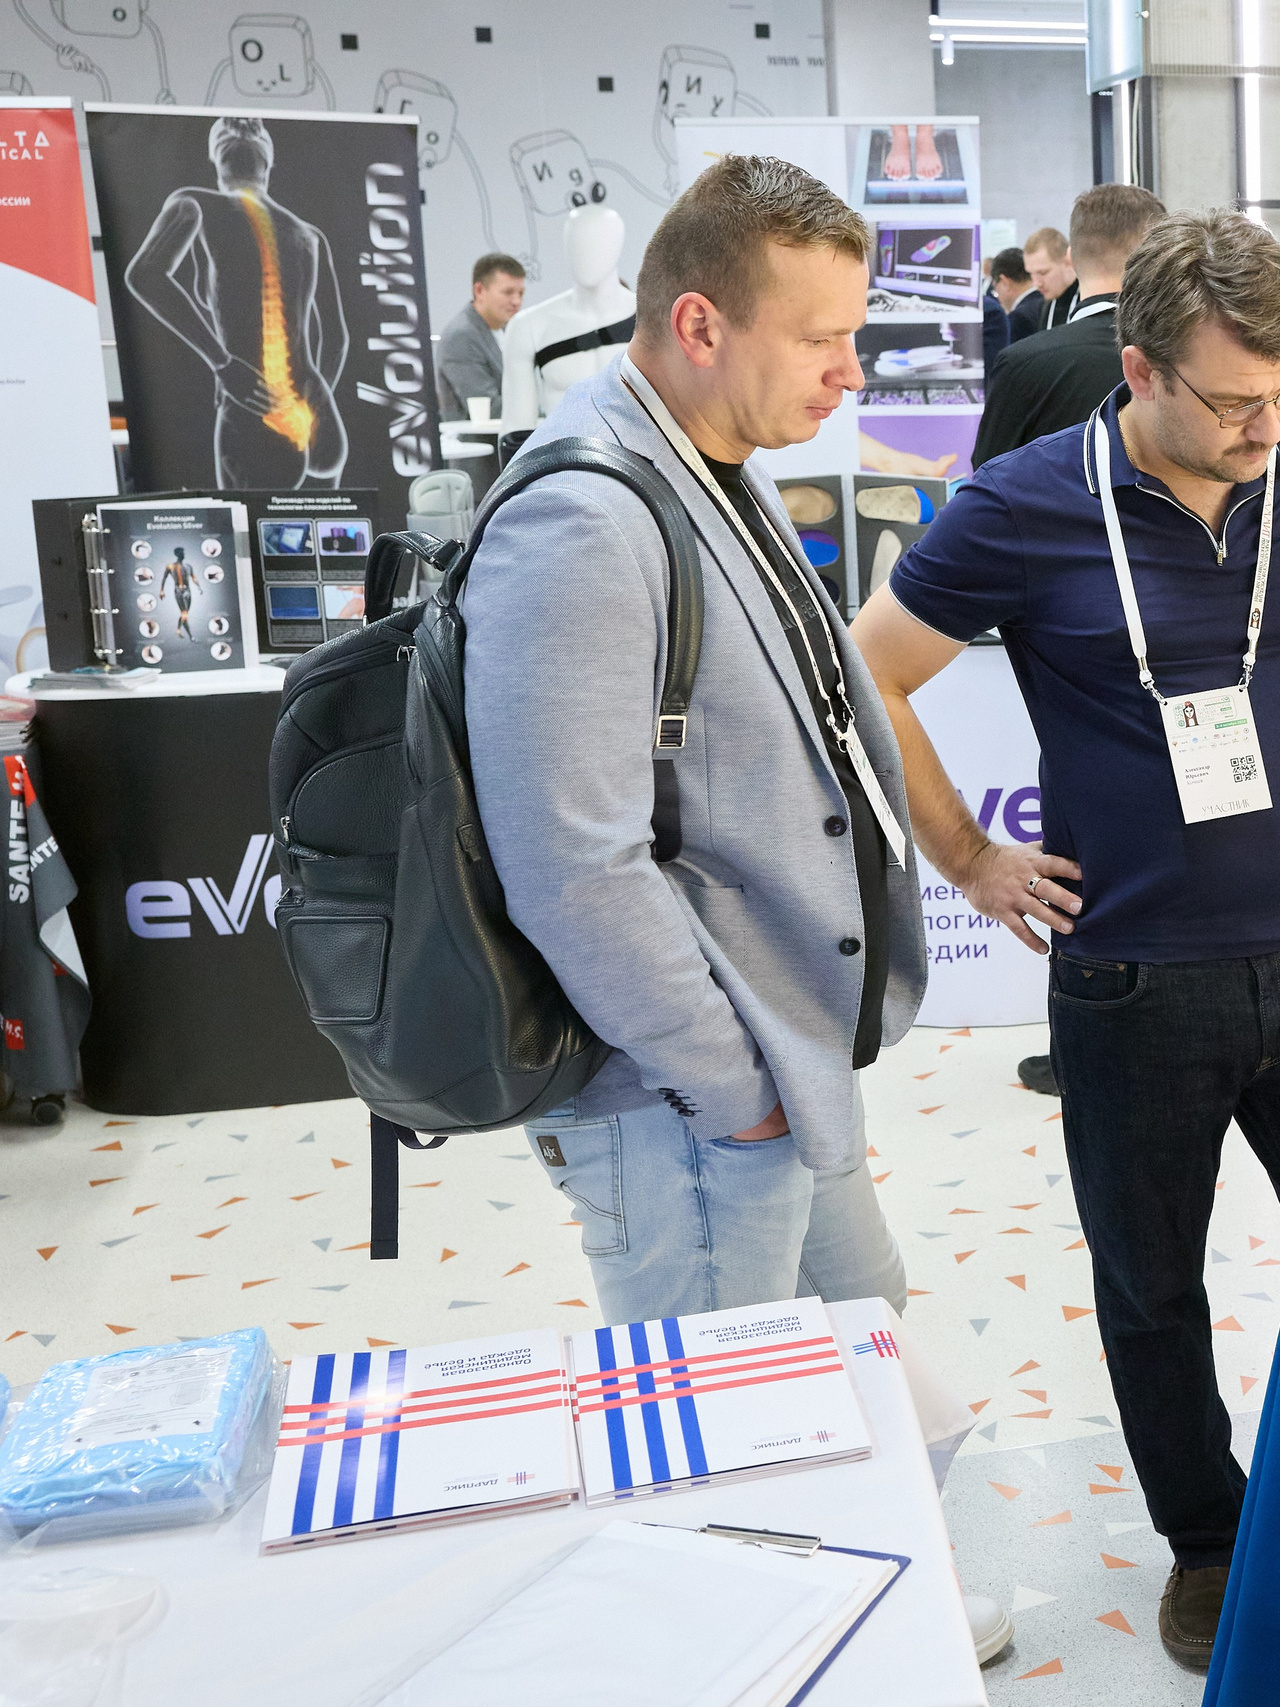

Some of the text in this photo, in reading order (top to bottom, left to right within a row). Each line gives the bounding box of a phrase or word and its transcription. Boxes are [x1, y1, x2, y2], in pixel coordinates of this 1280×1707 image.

[30, 836, 59, 872] NTE
[716, 1321, 801, 1338] медицинская
[751, 1316, 799, 1327] одежда
[717, 1325, 803, 1343] Одноразовая
[441, 1353, 531, 1372] медицинская
[480, 1348, 531, 1360] одежда
[442, 1358, 532, 1377] Одноразовая
[751, 1437, 802, 1451] ДАРПИКС
[443, 1478, 499, 1492] ДАРПИКС
